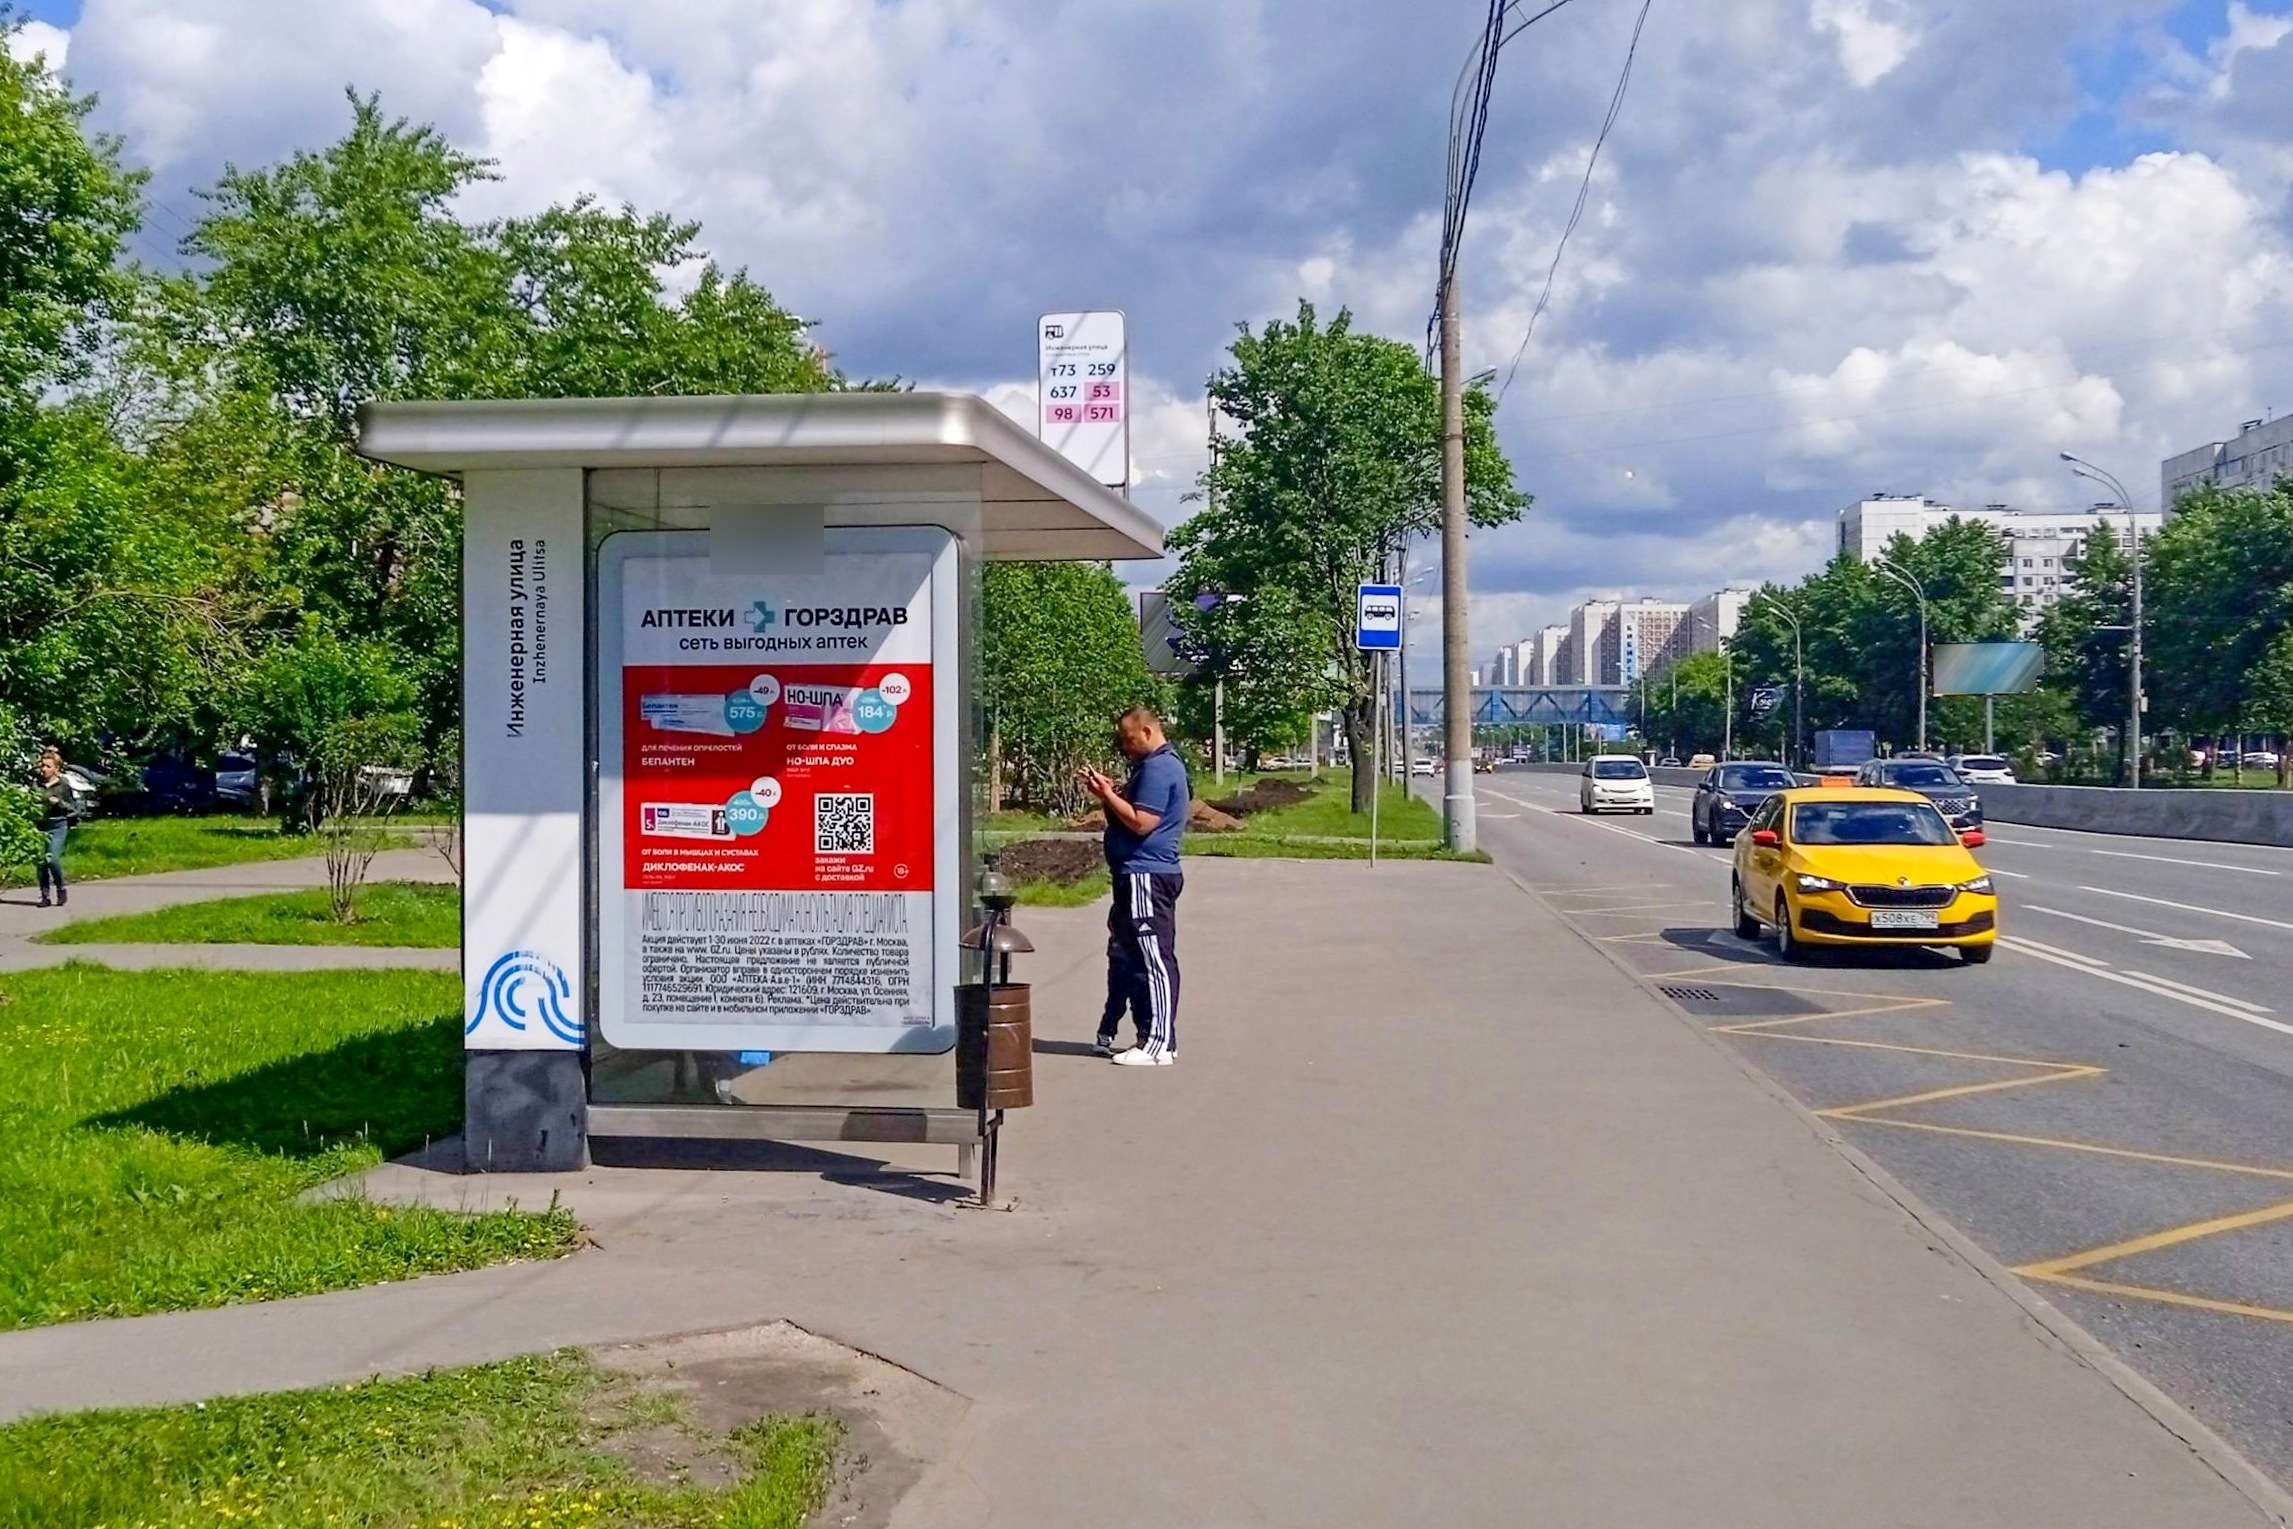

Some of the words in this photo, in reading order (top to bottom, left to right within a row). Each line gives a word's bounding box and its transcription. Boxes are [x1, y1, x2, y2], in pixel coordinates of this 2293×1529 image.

[1051, 364, 1076, 377] т73
[1088, 363, 1116, 376] 259
[1050, 386, 1077, 399] 637
[1093, 385, 1111, 398] 53
[1054, 408, 1073, 421] 98
[1090, 407, 1114, 420] 571
[532, 540, 546, 581] Ulitsa
[510, 539, 528, 600] улица
[641, 609, 735, 628] АПТЕКИ
[784, 607, 909, 629] ГОРЗДРАВ
[533, 586, 548, 684] Inzhenernaya
[679, 637, 719, 651] сеть
[723, 636, 812, 651] выгодных
[816, 635, 868, 650] аптек
[1626, 624, 1634, 682] БИБИРЕВ
[506, 606, 528, 738] Инженерная
[787, 688, 843, 707] НО-ШПА
[729, 706, 756, 719] 575
[641, 744, 658, 752] ДЛЯ
[658, 744, 693, 752] ЛЕЧЕНИЯ
[693, 743, 742, 752] ОПРЕЛОСТЕЙ
[641, 757, 695, 766] БЕПАНТЕН
[786, 757, 830, 765] НО-ШПА
[831, 757, 854, 767] ДУО
[729, 808, 757, 820] 390
[680, 849, 714, 857] МЫШЦАХ
[721, 849, 759, 857] СУСТАВАХ
[642, 862, 745, 873] ДИКЛОФЕНАК-АКОС
[827, 864, 851, 872] сайте
[851, 864, 875, 873] GZ.ru
[821, 873, 865, 881] доставкой
[642, 892, 675, 932] ИМЕЮТСЯ
[749, 892, 794, 932] НЕОБХОДИМА
[795, 893, 853, 932] КОНСУЛЬТАЦИЯ
[642, 935, 666, 946] Акция
[667, 936, 707, 947] действует
[727, 937, 748, 945] июня
[749, 935, 770, 945] 2022
[785, 938, 816, 946] аптеках
[817, 936, 868, 947] «ГОРЗДРАВ»
[650, 947, 673, 955] также
[735, 946, 757, 956] Цены
[760, 948, 792, 956] указаны
[832, 947, 879, 956] Количество
[882, 949, 909, 957] товара
[695, 955, 740, 965] Настоящее
[747, 956, 800, 966] предложение
[823, 958, 860, 966] является
[866, 957, 909, 967] публичной
[680, 964, 731, 974] Организатор
[733, 967, 760, 975] вправе
[770, 967, 832, 976] одностороннем
[834, 968, 868, 976] порядке
[870, 968, 909, 976] изменить
[642, 974, 674, 984] условия
[710, 974, 727, 983] ООО
[888, 977, 909, 986] ОГРН
[706, 985, 760, 995] Юридический
[666, 995, 712, 1003] помещение
[720, 995, 753, 1003] комната
[832, 996, 892, 1006] действительна
[894, 997, 910, 1007] при
[642, 1004, 674, 1013] покупке
[676, 1004, 685, 1012] на
[687, 1003, 709, 1012] сайте
[723, 1004, 768, 1013] мобильном
[769, 1005, 819, 1014] приложении
